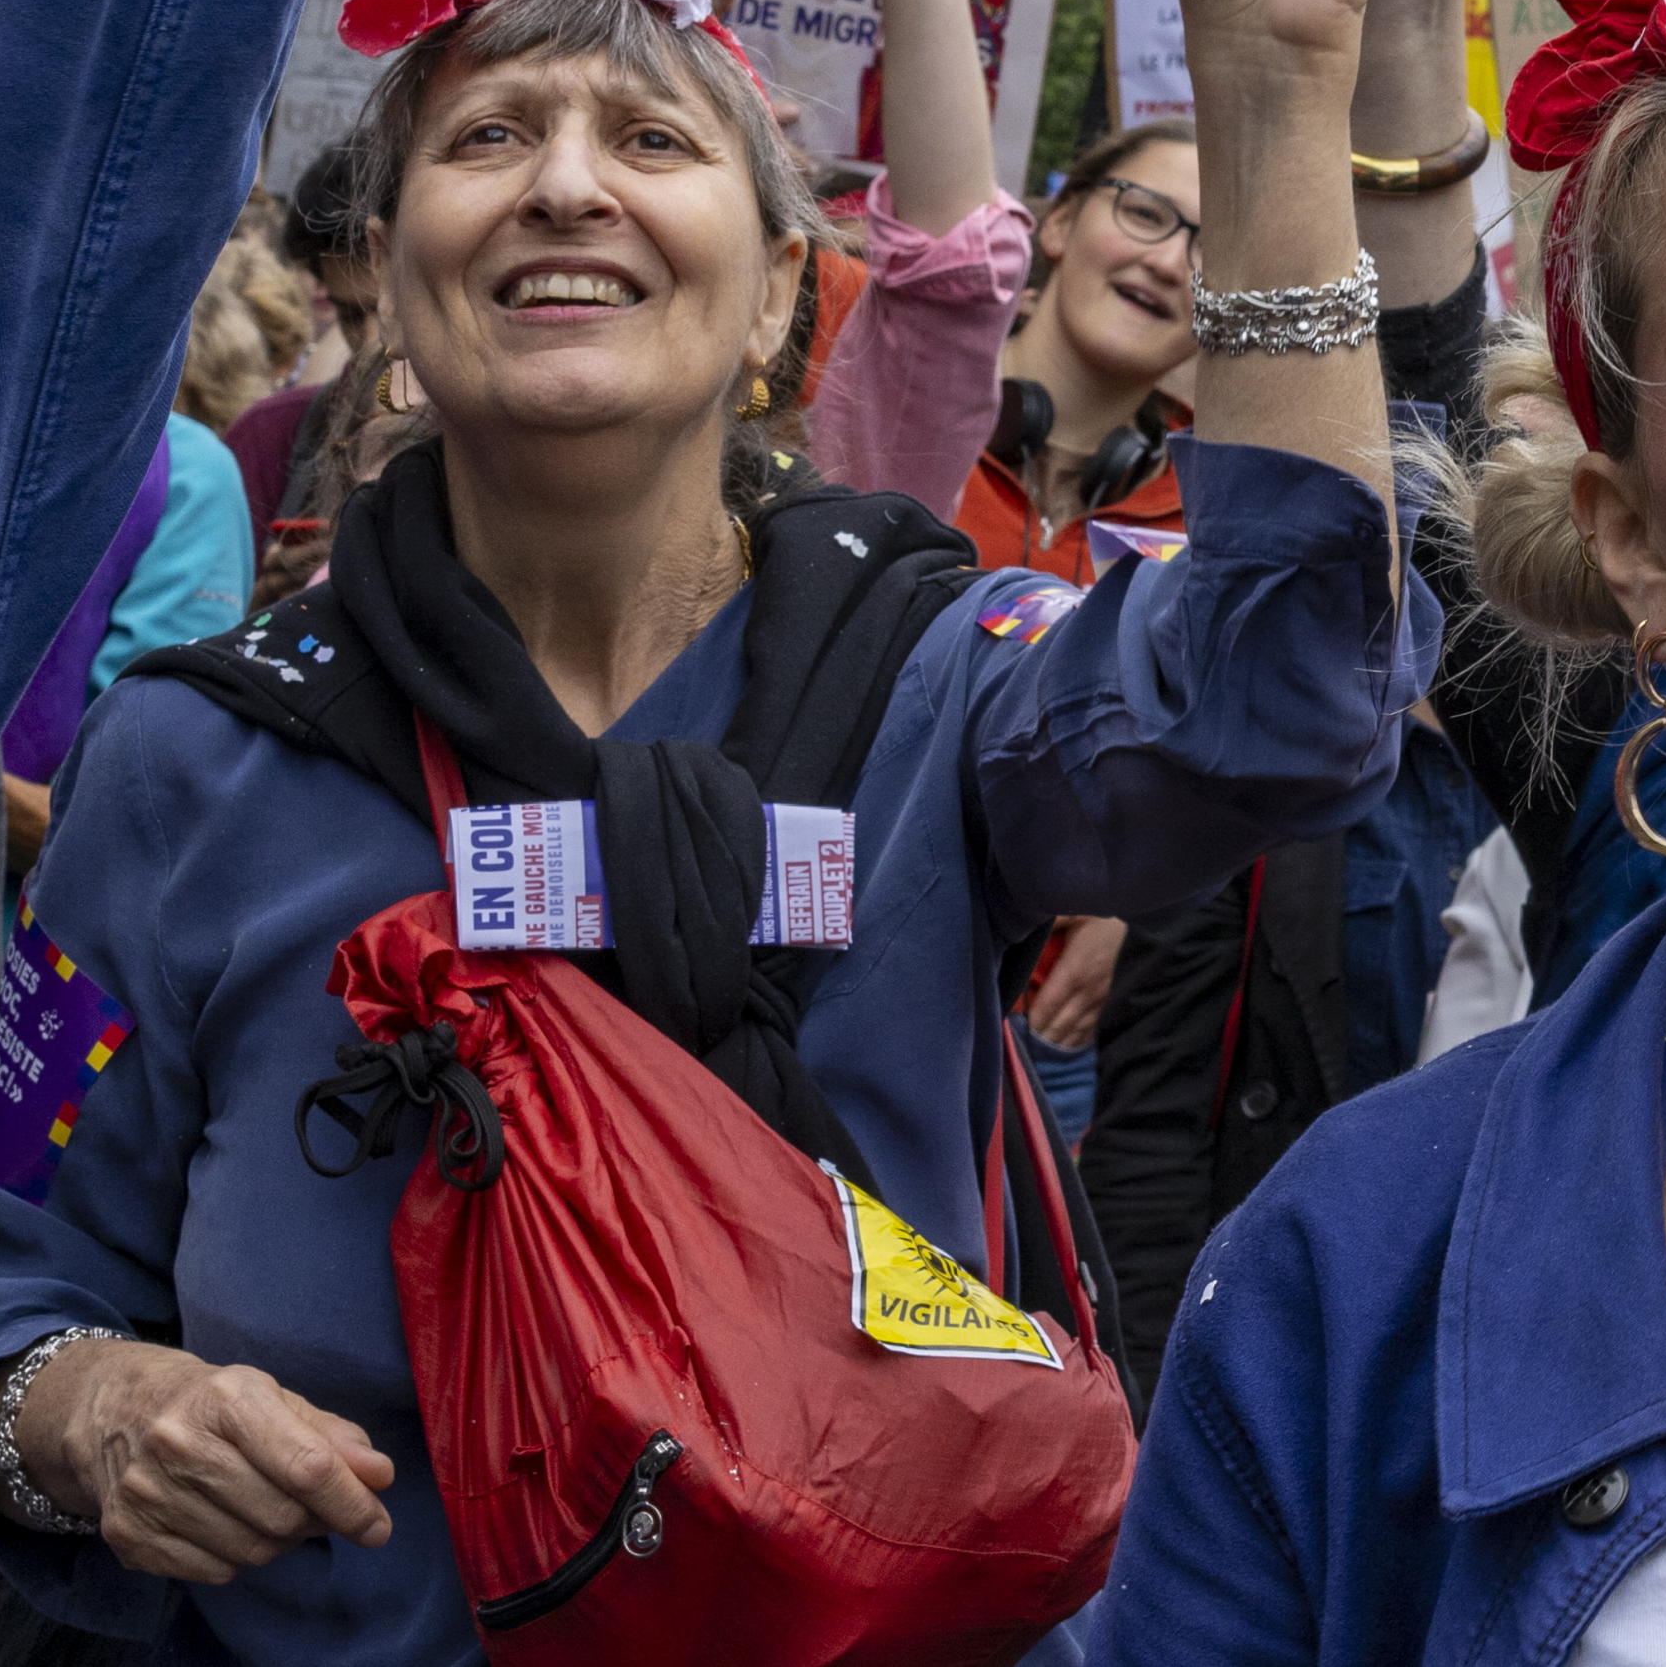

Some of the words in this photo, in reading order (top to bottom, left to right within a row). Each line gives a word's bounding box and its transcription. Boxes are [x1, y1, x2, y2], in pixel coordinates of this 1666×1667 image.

[547, 826, 565, 917] DEMOISELLE
[820, 843, 843, 856] 2
[524, 843, 545, 915] GAUCHE
[787, 865, 813, 941] REFRAIN
[821, 861, 847, 941] COUPLET
[473, 887, 515, 930] EN
[577, 901, 601, 949] PONT
[761, 895, 774, 918] FAIRE
[763, 919, 776, 944] VIENS
